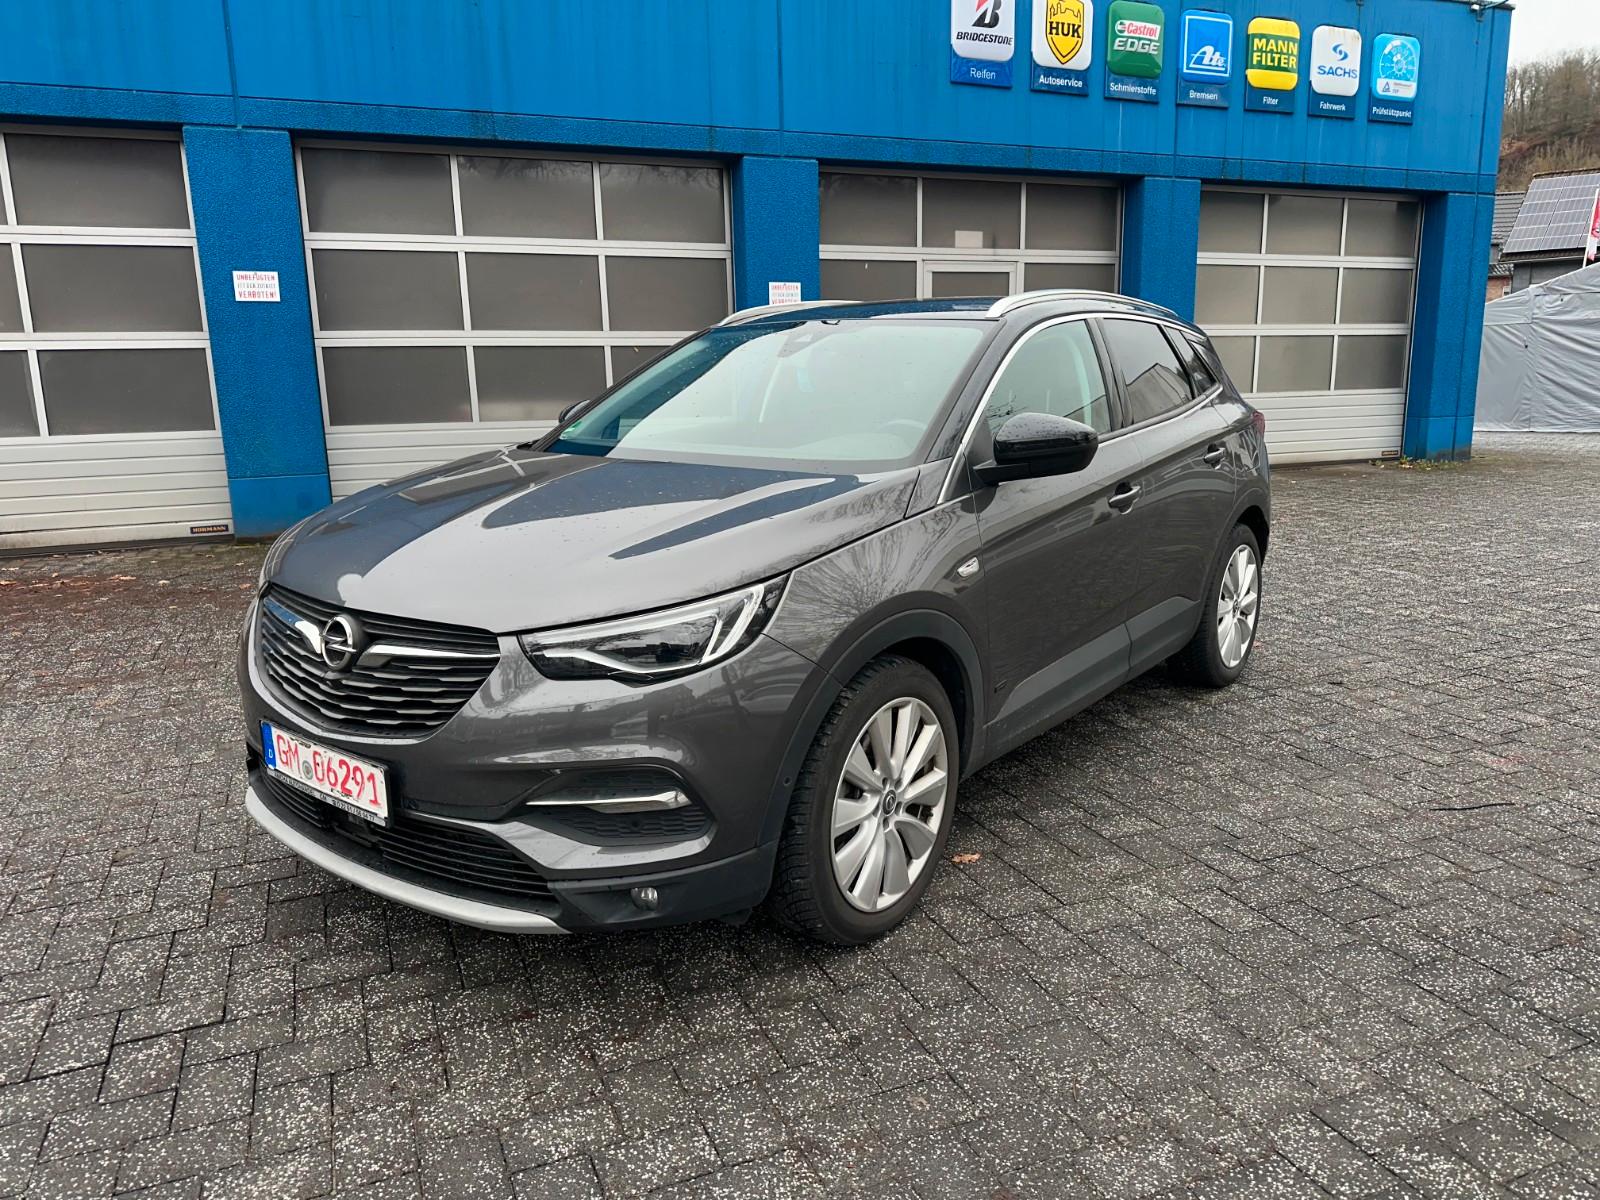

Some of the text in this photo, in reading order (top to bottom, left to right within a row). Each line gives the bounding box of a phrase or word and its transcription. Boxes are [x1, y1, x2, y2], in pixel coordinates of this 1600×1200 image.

[1048, 20, 1081, 39] HUK
[1126, 22, 1158, 37] Castrol
[956, 31, 1013, 46] BRIDGESTONE
[1113, 37, 1160, 54] EDGE
[1253, 38, 1298, 54] MANN
[1252, 53, 1297, 69] FILTER
[970, 68, 996, 79] Reifen
[1317, 64, 1358, 79] SACHS
[1039, 75, 1083, 88] Autoservice
[1110, 82, 1157, 95] Schmierstoffe
[1189, 90, 1218, 101] Bremsen
[1263, 96, 1279, 105] Filter
[1319, 101, 1346, 111] Fahrwerk
[236, 273, 275, 281] UNBEFUGTEN
[276, 734, 301, 776] GM
[312, 750, 380, 806] 06291
